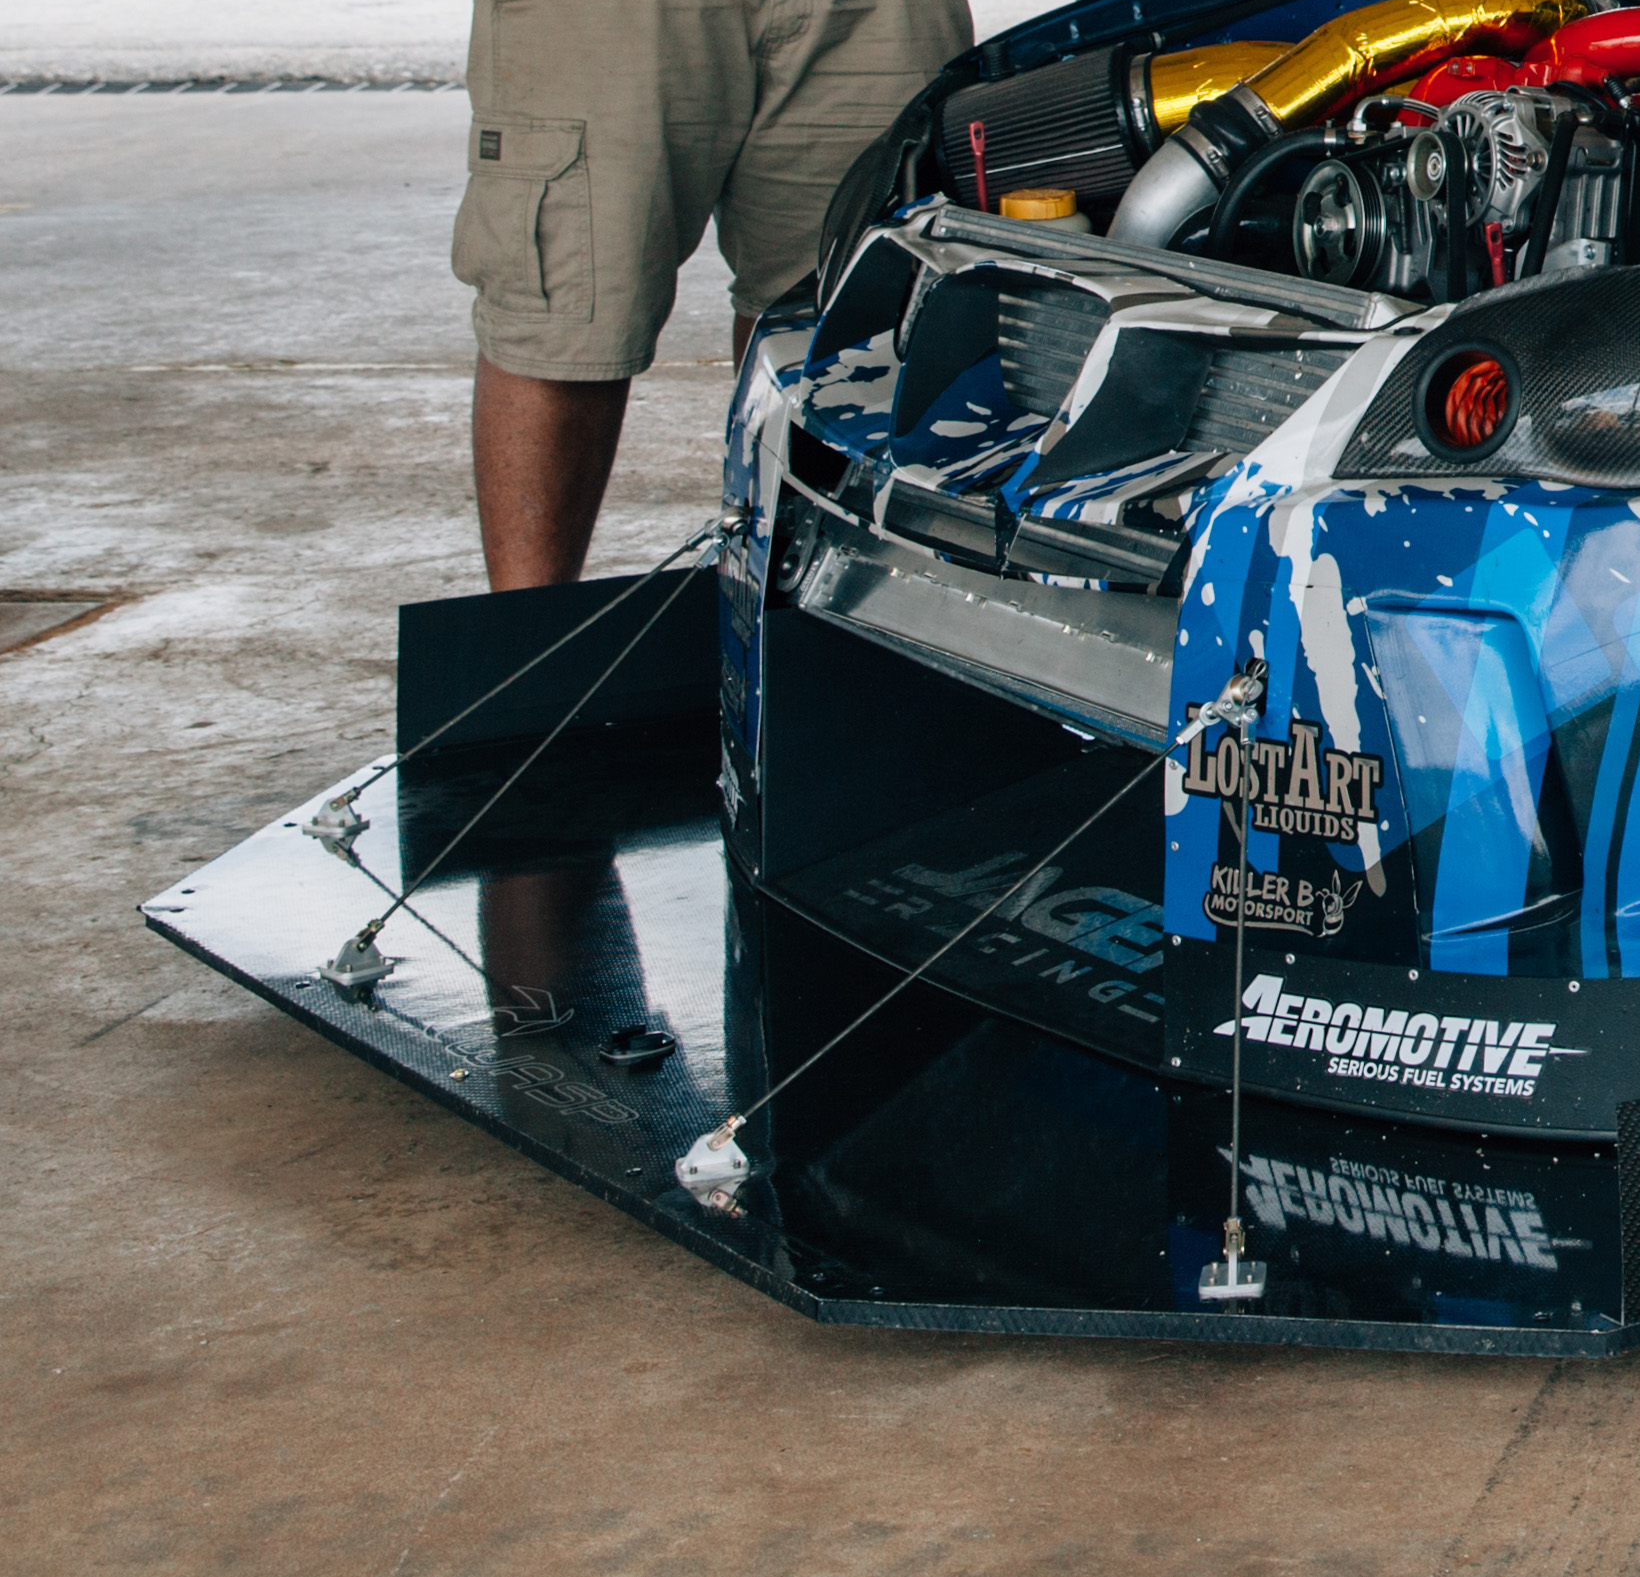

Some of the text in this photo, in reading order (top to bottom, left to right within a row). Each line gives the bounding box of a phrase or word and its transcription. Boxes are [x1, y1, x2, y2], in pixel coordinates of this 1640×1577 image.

[1254, 804, 1355, 841] LIQUIDS
[1212, 865, 1315, 907] KILLER B
[893, 851, 1165, 973] JAGE
[1214, 973, 1558, 1077] AEROMOTIVE
[1327, 1057, 1536, 1097] SERIOUS FUEL SYSTEMS
